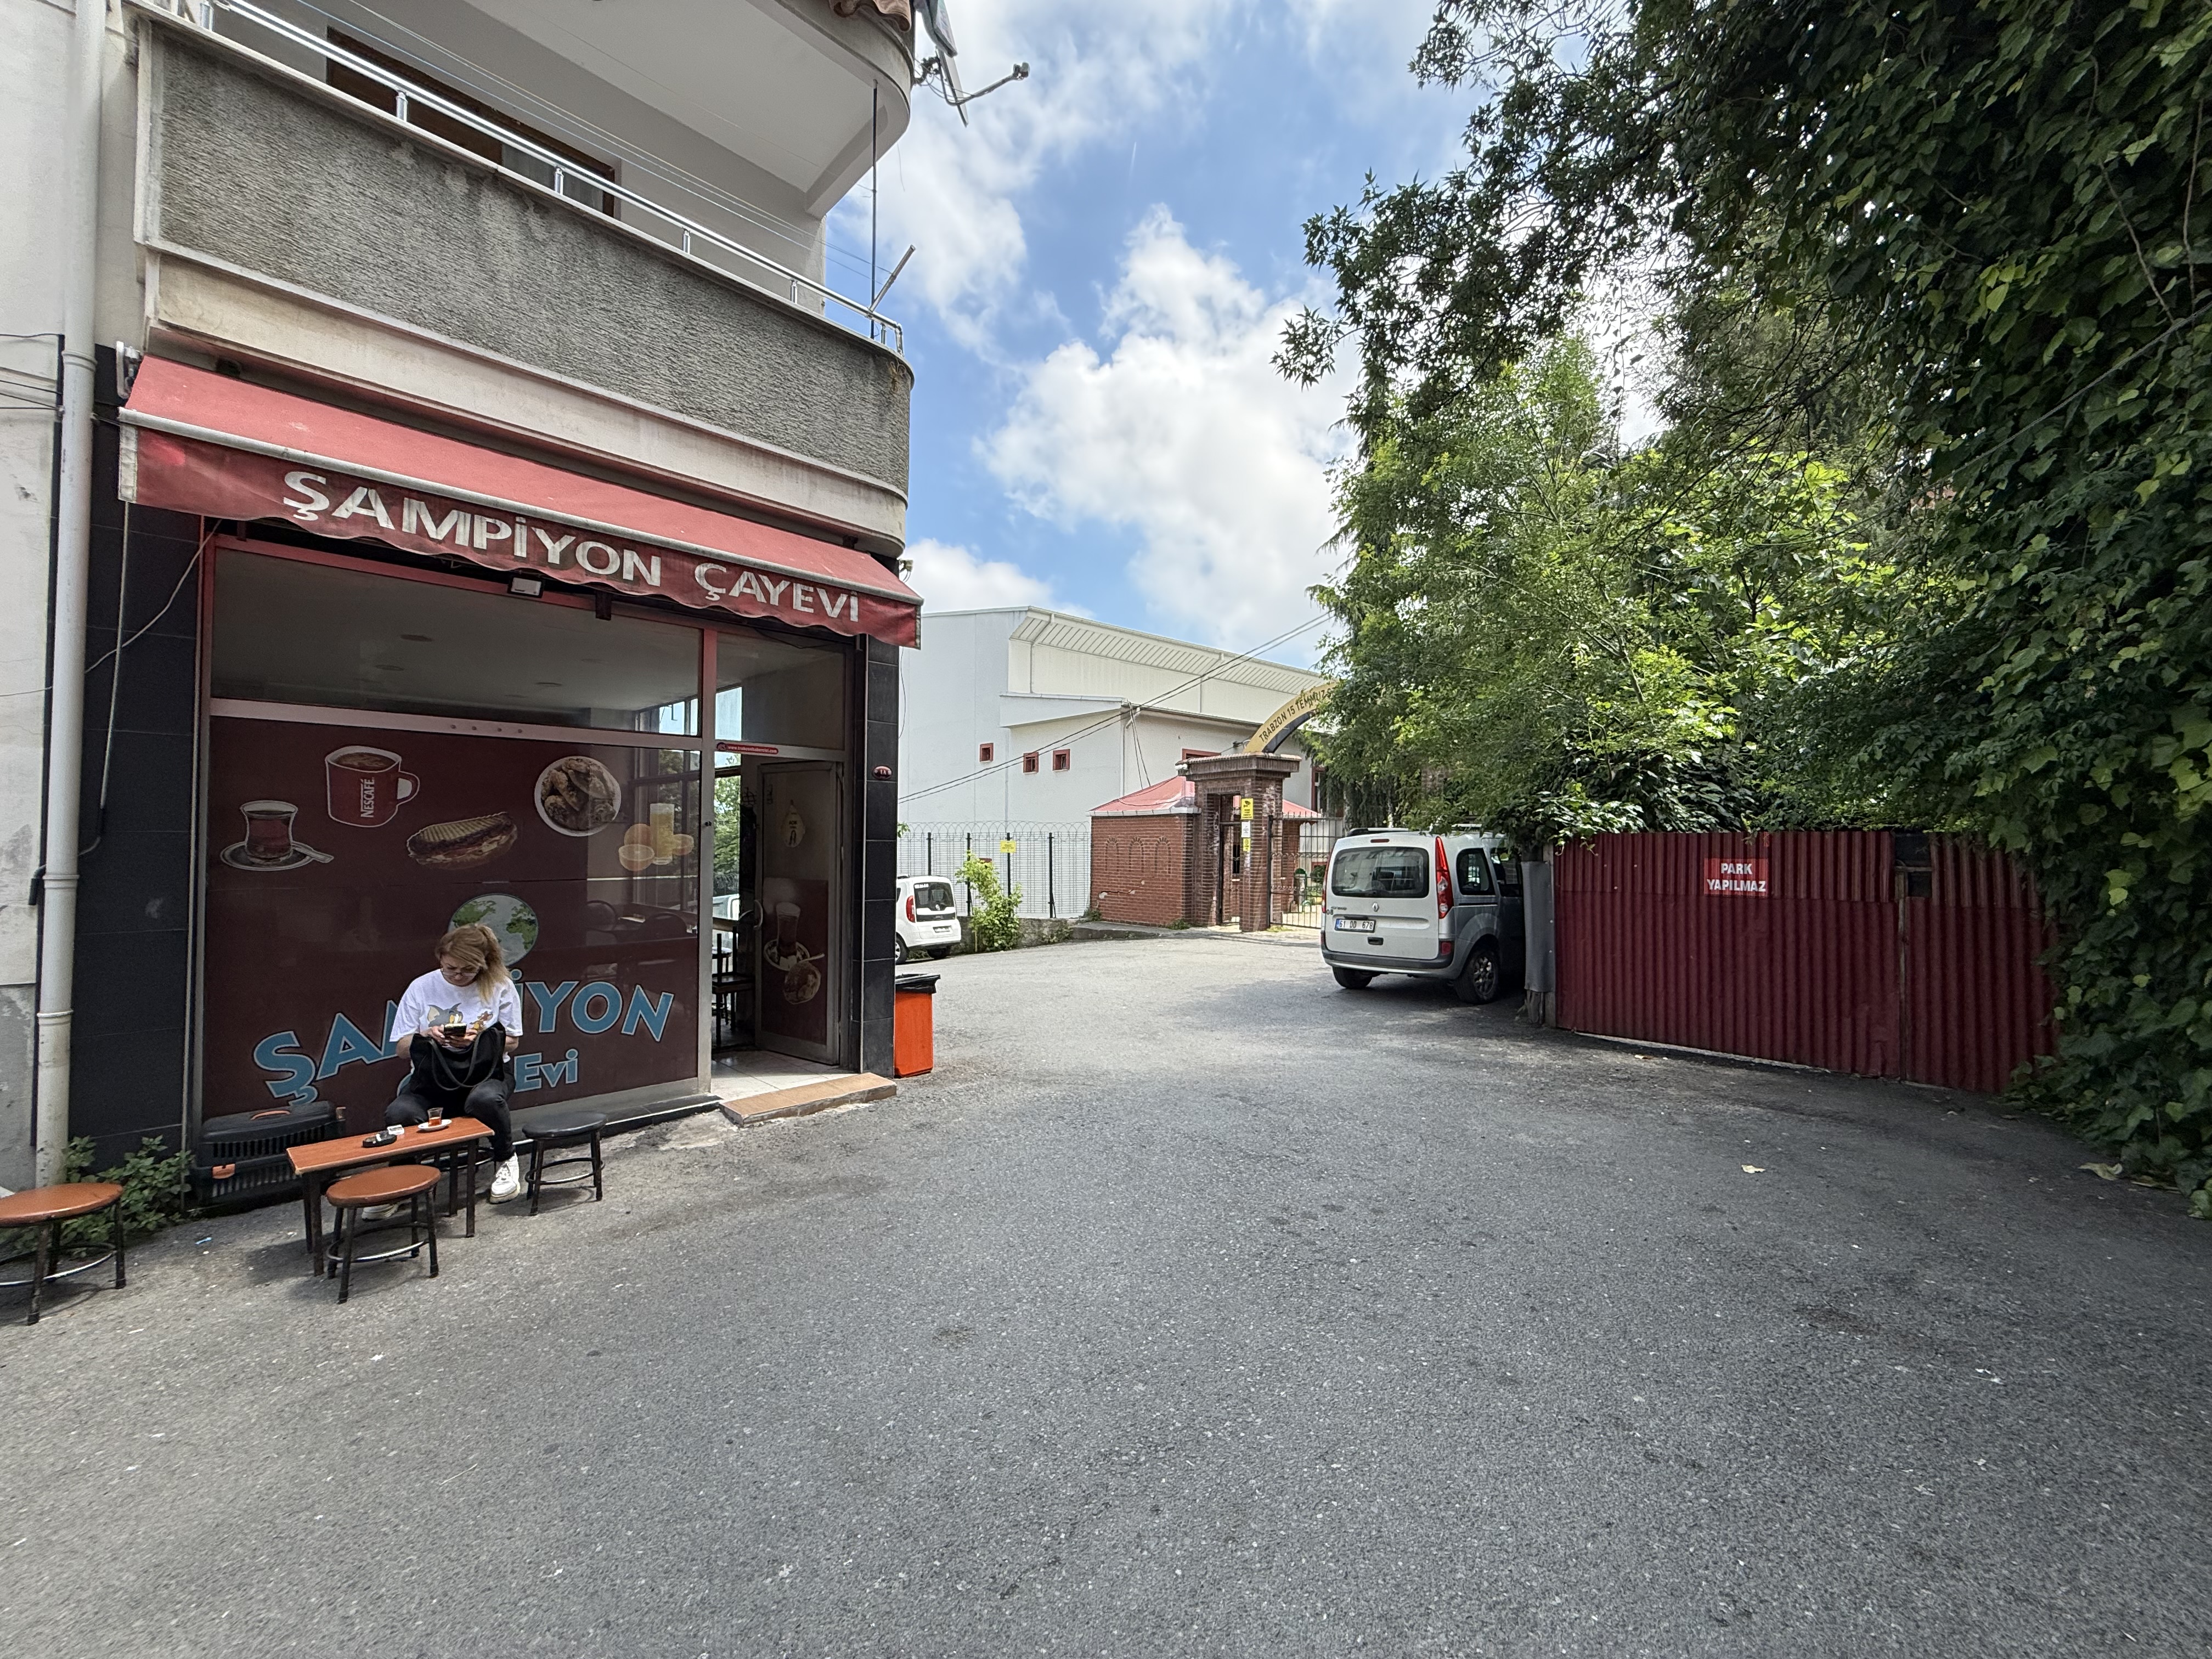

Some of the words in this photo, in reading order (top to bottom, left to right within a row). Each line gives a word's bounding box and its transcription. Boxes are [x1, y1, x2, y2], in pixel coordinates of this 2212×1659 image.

[283, 471, 661, 586] ŞAMPİYON
[695, 563, 858, 622] ÇAYEVİ
[1259, 711, 1287, 742] TRABZON
[1287, 706, 1295, 717] 15
[360, 777, 375, 817] NESCAFÉ
[1707, 879, 1767, 892] YAPILMAZ
[1720, 863, 1753, 875] PARK
